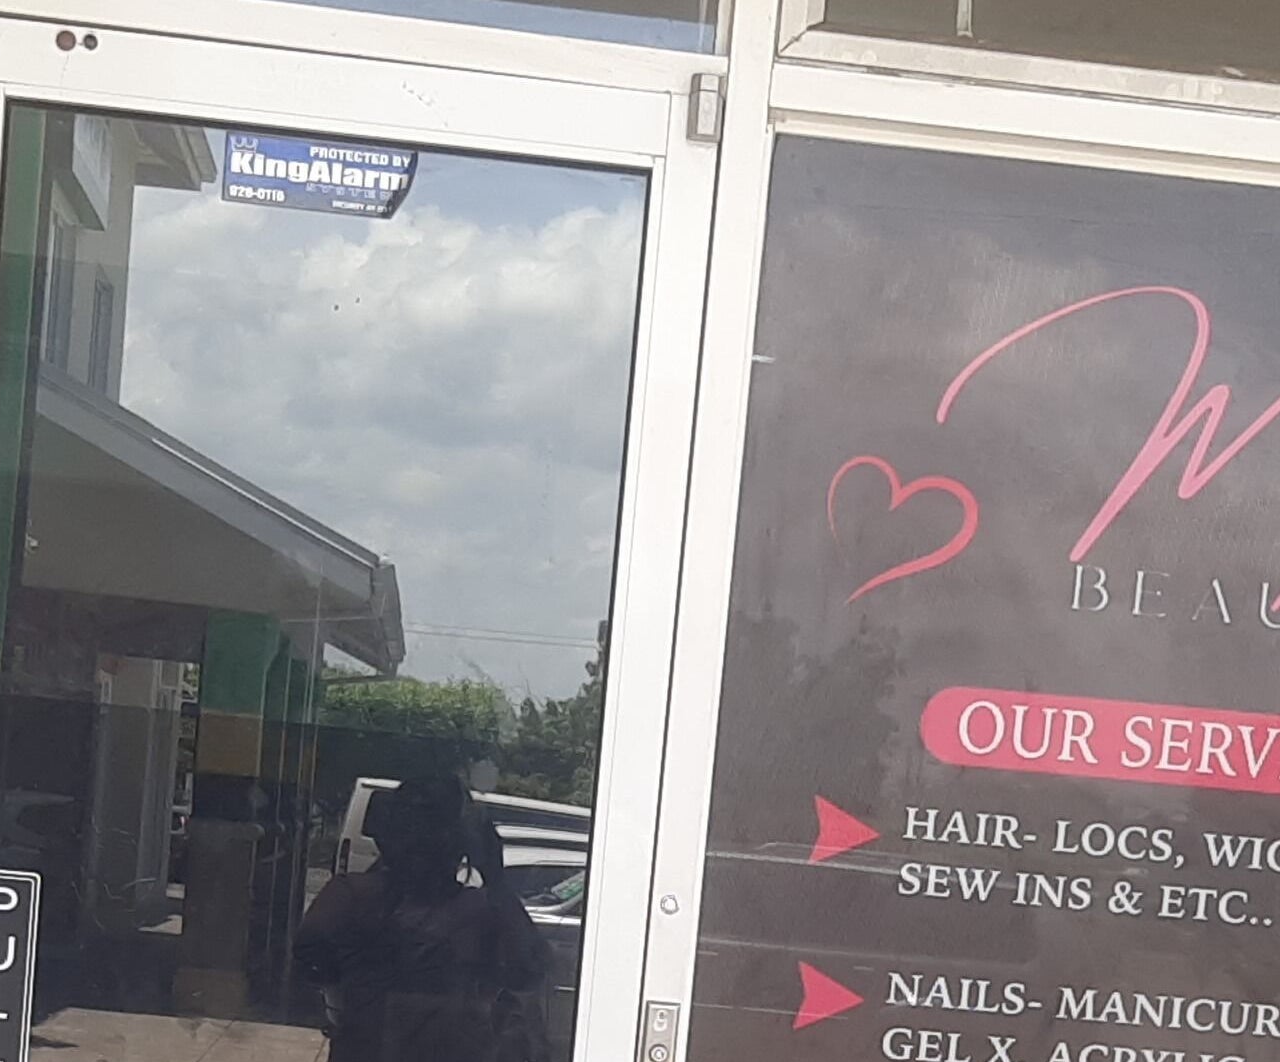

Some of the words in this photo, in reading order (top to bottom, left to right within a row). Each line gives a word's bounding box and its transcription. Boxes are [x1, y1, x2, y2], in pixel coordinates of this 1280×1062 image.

[231, 151, 409, 190] KingAlarm
[310, 146, 388, 165] PROTECTED
[394, 156, 411, 167] BY
[958, 700, 1098, 766] OUR
[902, 806, 1036, 850] HAIR-
[1052, 819, 1185, 869] LOCS,
[896, 862, 1000, 903] SEW
[1012, 871, 1092, 911] INS
[1107, 880, 1143, 917] &
[1158, 884, 1273, 928] ETC..
[887, 971, 1043, 1016] NAILS-
